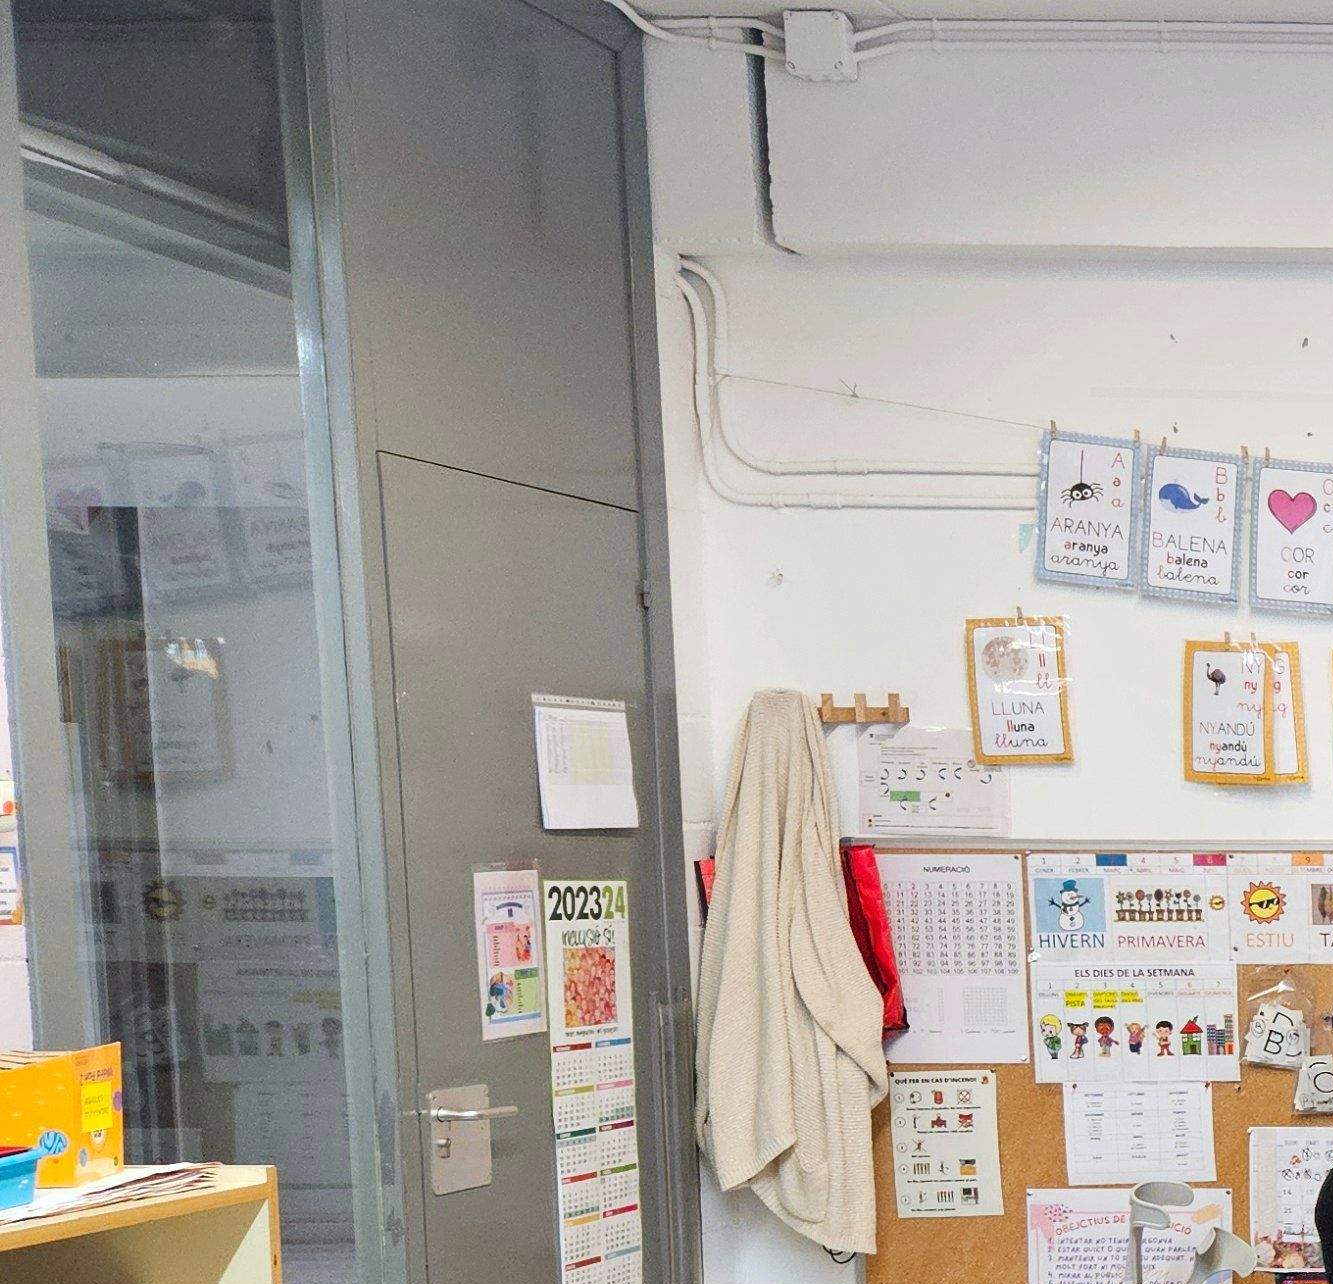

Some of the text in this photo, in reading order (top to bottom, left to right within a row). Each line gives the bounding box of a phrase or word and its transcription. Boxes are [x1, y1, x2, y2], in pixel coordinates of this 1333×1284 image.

[1112, 453, 1126, 470] A
[1216, 466, 1228, 485] B
[1051, 518, 1124, 540] ARANYA
[1064, 539, 1108, 556] aranya
[1152, 532, 1227, 555] BALENA
[1050, 552, 1119, 572] aranya
[1166, 552, 1208, 568] balena
[1280, 546, 1315, 564] COR
[1157, 565, 1220, 586] balena
[1288, 569, 1309, 580] cor
[1283, 581, 1311, 595] cor
[991, 701, 1045, 715] LLUNA
[1007, 720, 1035, 732] lluna
[1199, 721, 1256, 737] NYANDÚ
[995, 734, 1048, 748] lluna
[1209, 739, 1248, 753] nyandú
[548, 886, 602, 921] 2023
[1039, 934, 1105, 948] HIVERN
[1118, 936, 1206, 948] PRIMAVERA
[1246, 933, 1294, 947] ESTIU
[1074, 969, 1195, 978] ELS DIES DE LA SETMANA
[1113, 1215, 1126, 1223] DE
